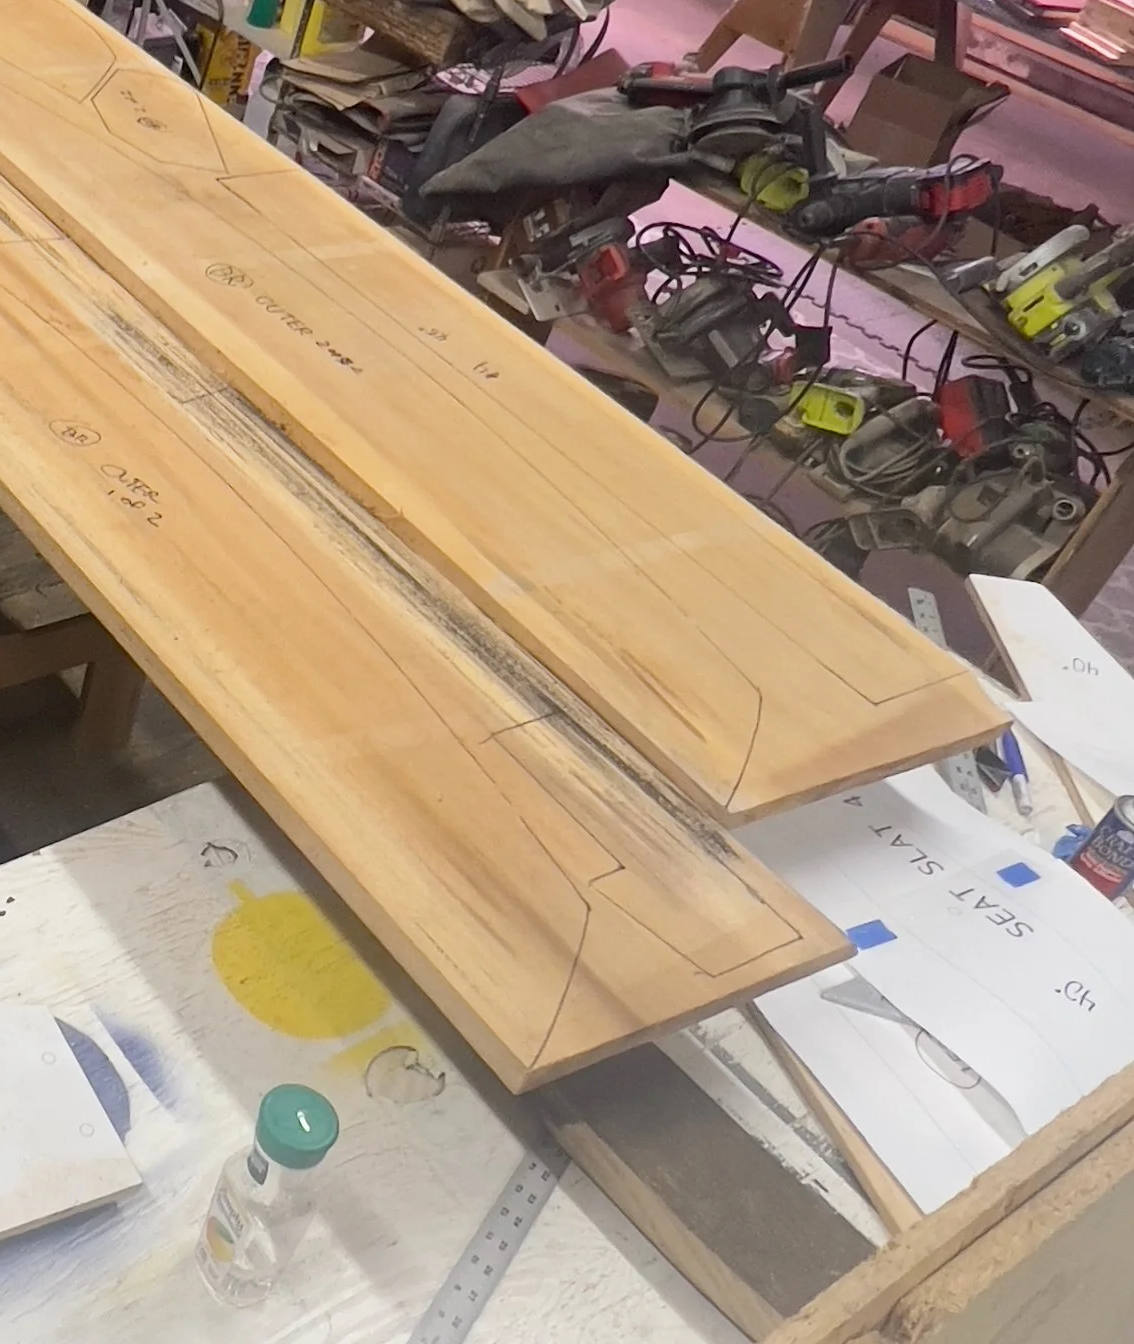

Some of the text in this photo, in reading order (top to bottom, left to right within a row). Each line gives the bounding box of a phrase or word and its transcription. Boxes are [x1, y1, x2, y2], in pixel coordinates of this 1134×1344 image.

[255, 295, 313, 337] OUTER
[101, 464, 159, 504] OUTER
[147, 512, 163, 528] 2
[842, 795, 1034, 938] SEAT SLAT 4
